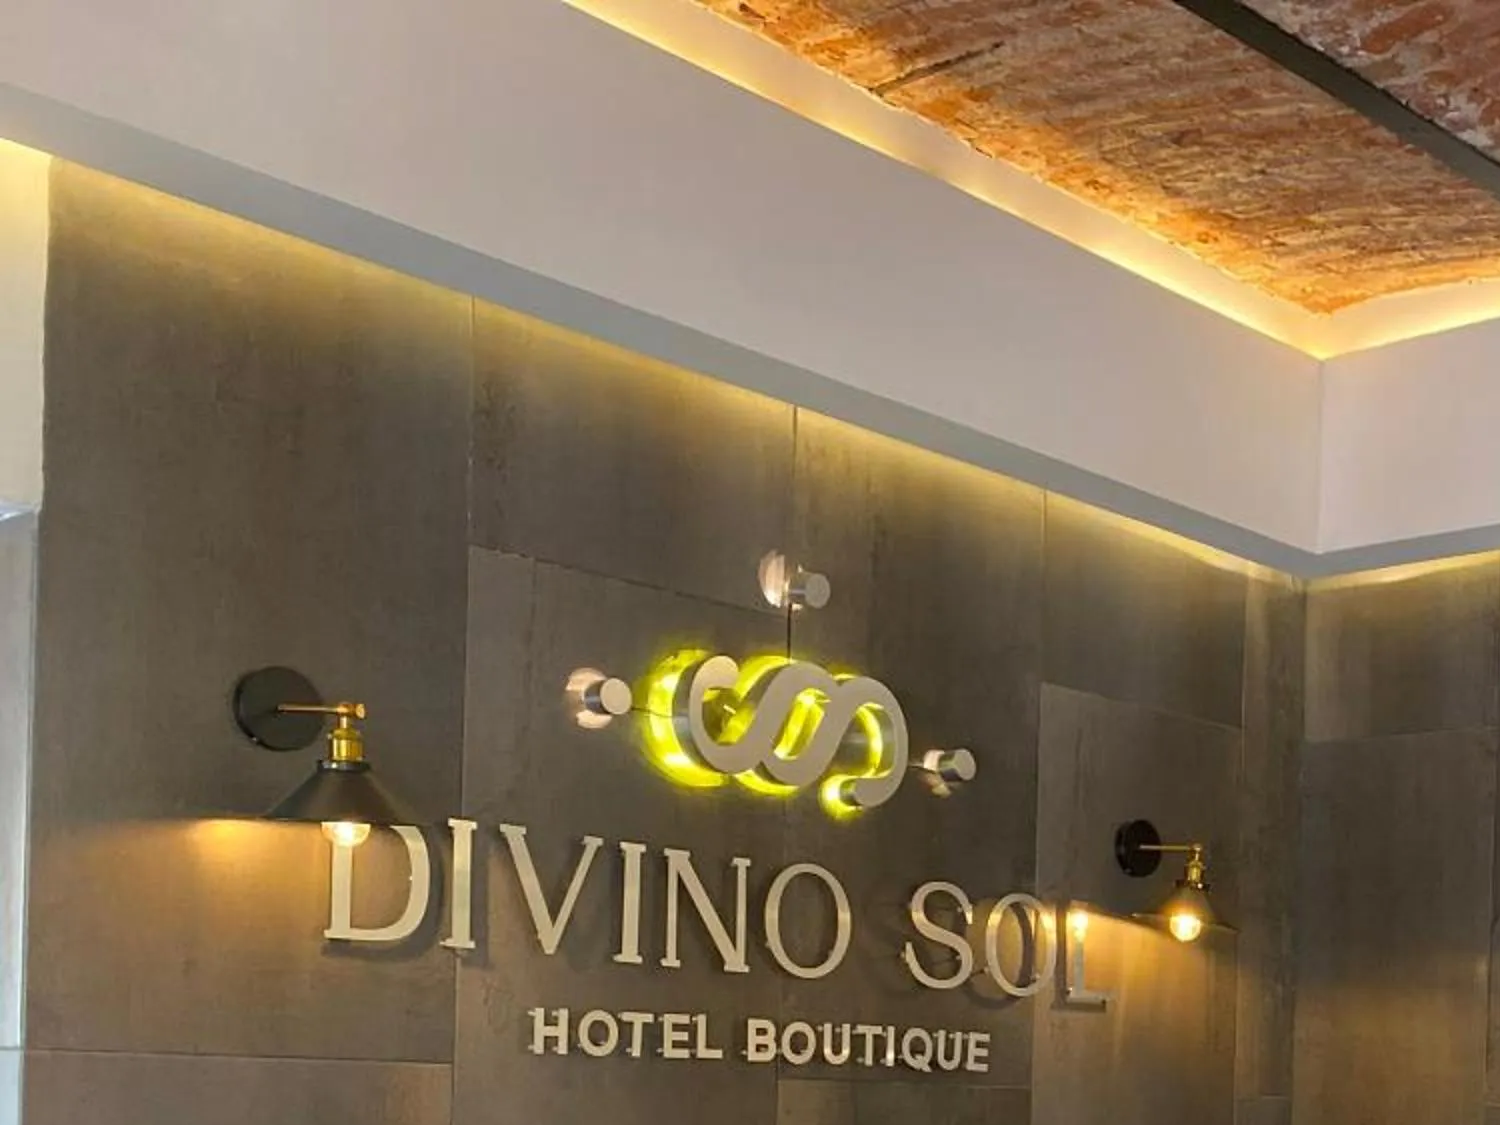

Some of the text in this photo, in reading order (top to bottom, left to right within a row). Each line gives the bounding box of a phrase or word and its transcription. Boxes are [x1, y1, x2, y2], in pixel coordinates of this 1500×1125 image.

[323, 818, 1110, 1005] DIVINO SOL
[528, 1007, 992, 1072] HOTEL BOUTIQUE
